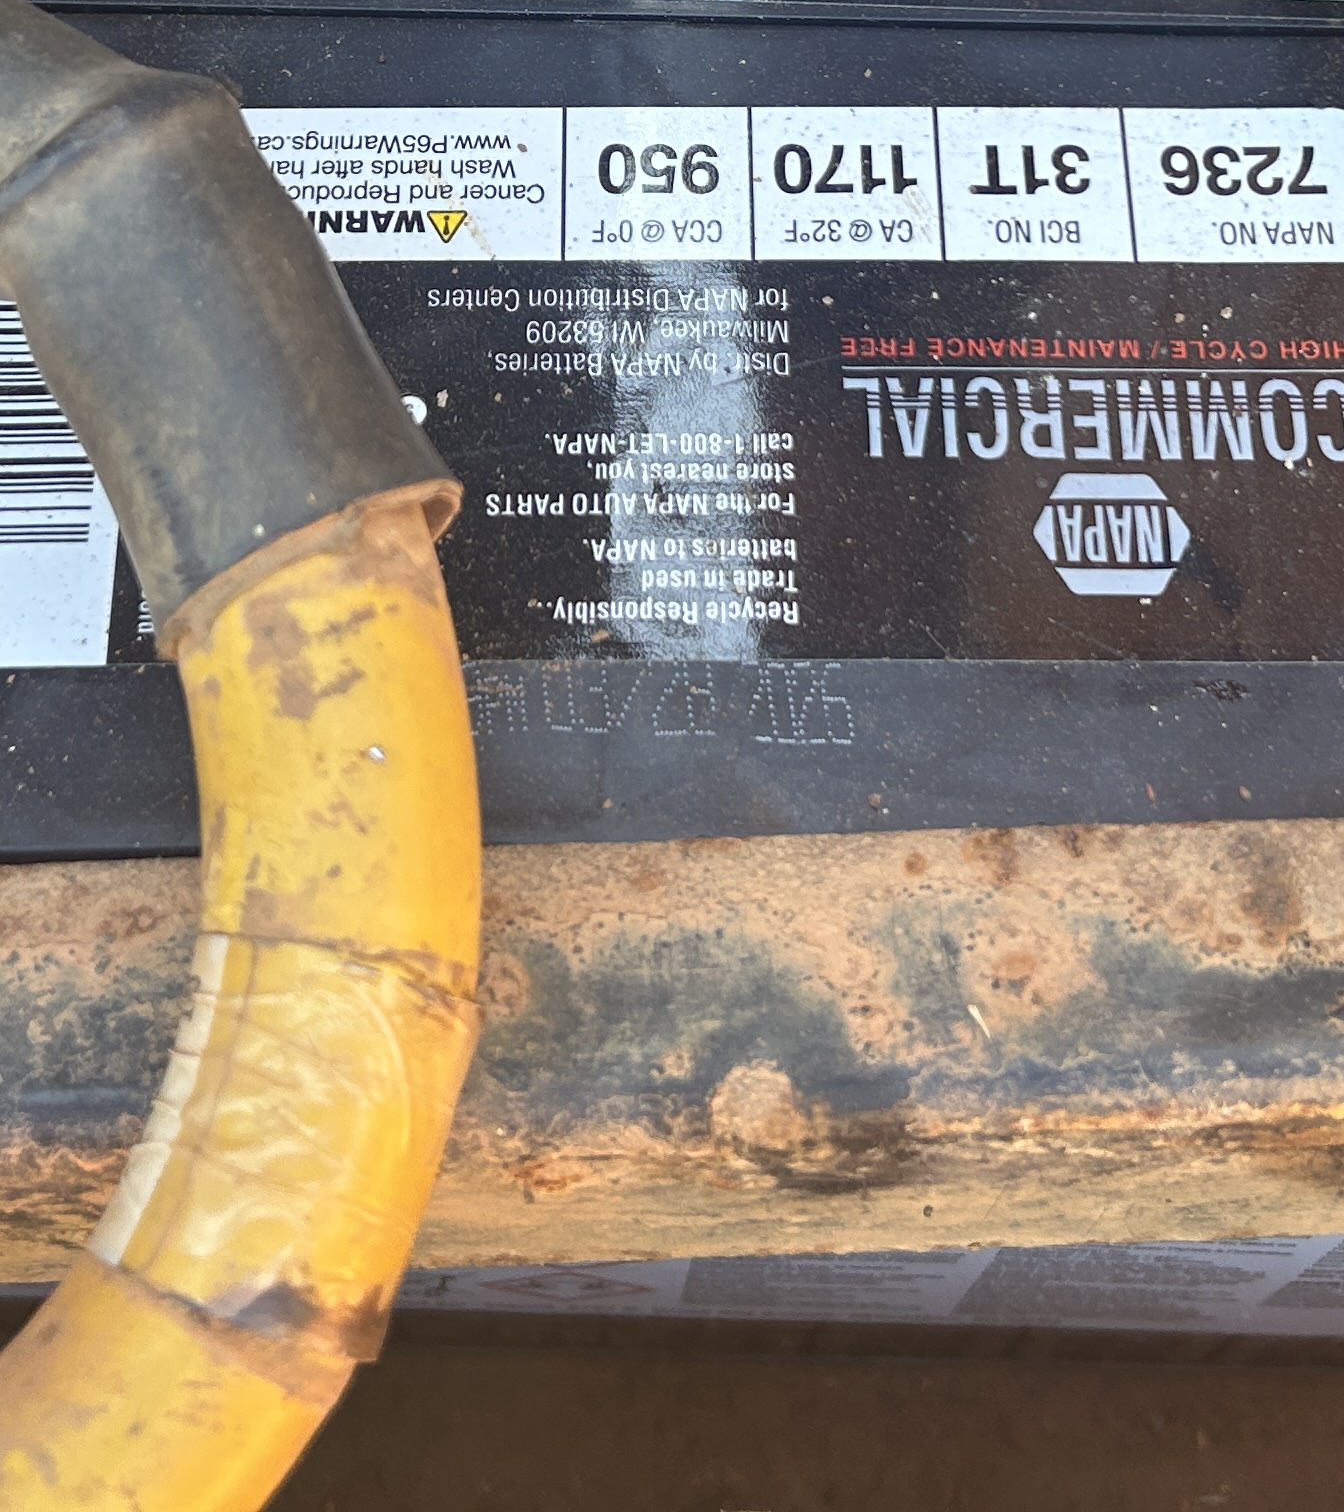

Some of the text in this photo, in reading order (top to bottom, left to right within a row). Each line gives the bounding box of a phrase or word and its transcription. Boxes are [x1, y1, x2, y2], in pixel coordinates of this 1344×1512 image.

[251, 131, 511, 153] www.P65Warnings.ca.
[313, 159, 364, 178] after
[372, 159, 442, 179] hands
[451, 159, 515, 179] Wash
[598, 144, 719, 193] 950
[773, 143, 918, 194] 1170
[969, 144, 1090, 194] 31T
[1161, 145, 1328, 196] 7236
[283, 180, 545, 204] Cancer and Reproduc
[302, 210, 425, 233] WARNI
[592, 218, 723, 243] CCA @ 0°F
[785, 218, 913, 242] CA @ 32°F
[988, 220, 1080, 242] BCI NO.
[1212, 221, 1334, 243] NAPA NO.
[428, 287, 788, 312] for NAPA Distribution Centers
[526, 317, 788, 343] Milwaukee, WI 53209
[840, 337, 916, 357] FREE
[927, 337, 1140, 357] MAINTENANCE
[1170, 338, 1267, 359] CYCLE
[488, 348, 789, 376] Distr. by NAPA Batteries,
[545, 432, 793, 454] call 1-800-LET-NAPA.
[586, 457, 794, 482] store nearest you,
[486, 492, 794, 516] For the NAPA AUTO PARTS
[1056, 506, 1165, 563] NAPA
[583, 538, 796, 561] batteries to NAPA.
[642, 570, 798, 592] Trade in used
[706, 598, 798, 624] Recycle
